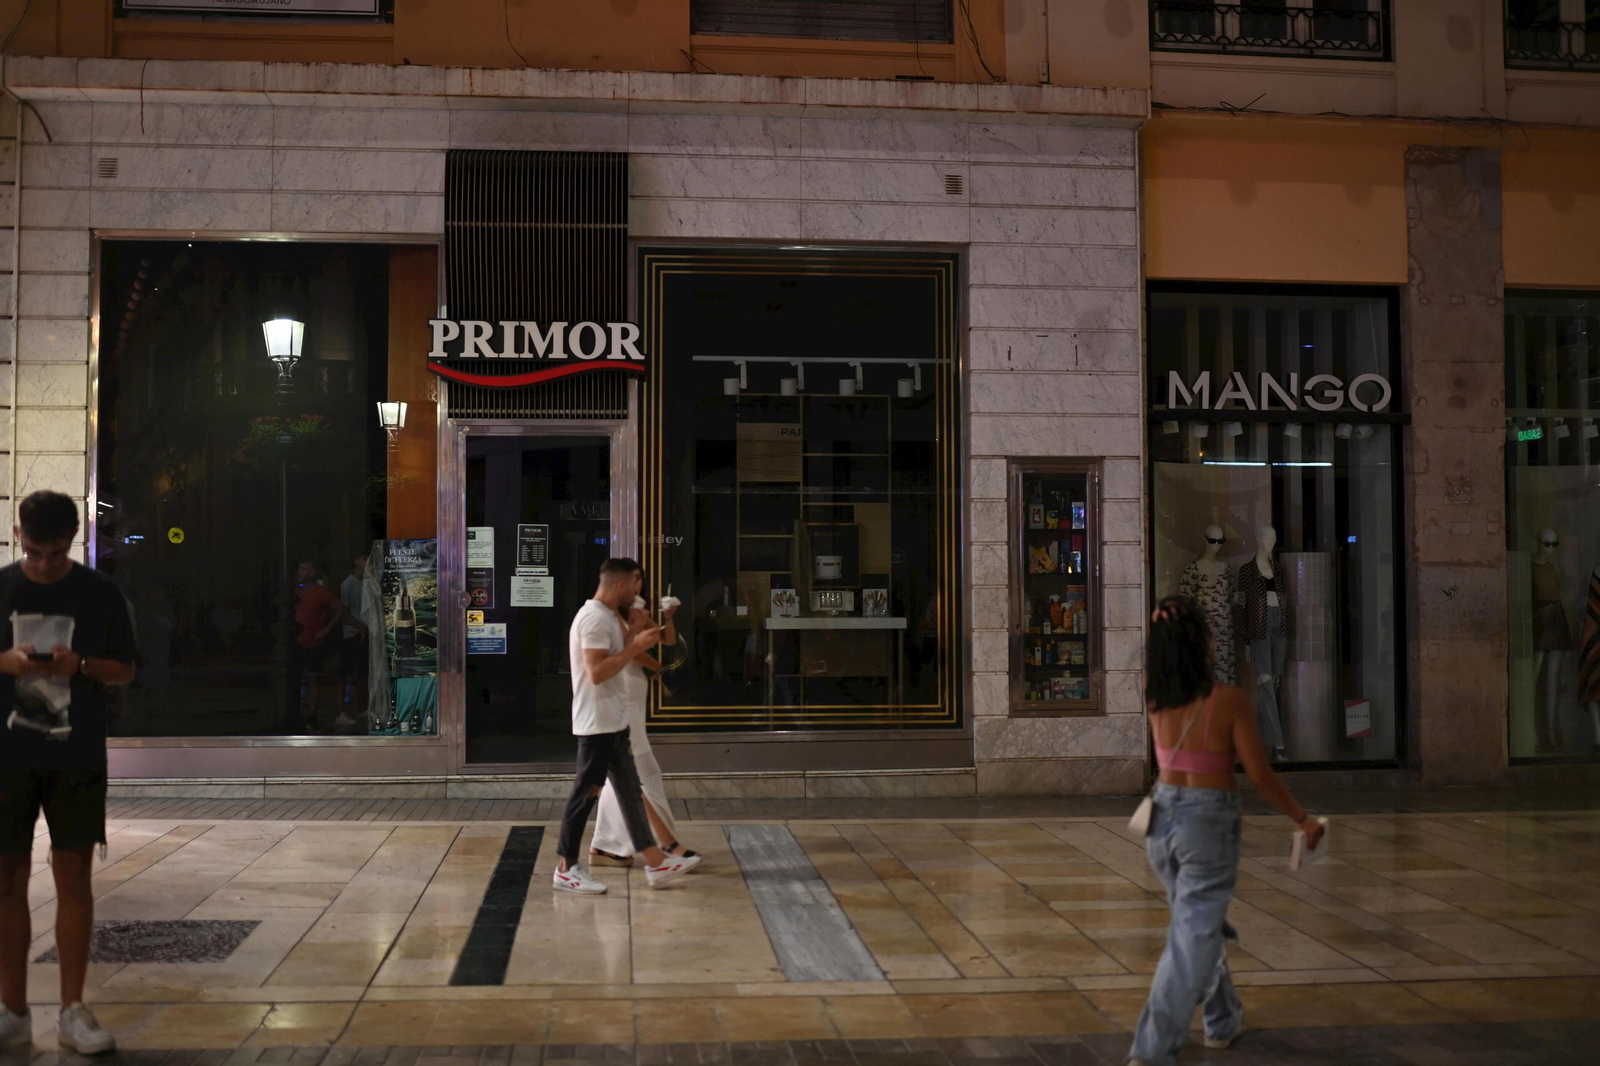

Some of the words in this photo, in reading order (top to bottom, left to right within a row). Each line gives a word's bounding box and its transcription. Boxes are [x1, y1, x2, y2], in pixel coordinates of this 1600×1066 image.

[428, 319, 645, 360] PRIMOR
[1168, 370, 1392, 413] MANGO
[389, 548, 417, 556] FUENTE
[395, 555, 423, 563] FUERZA
